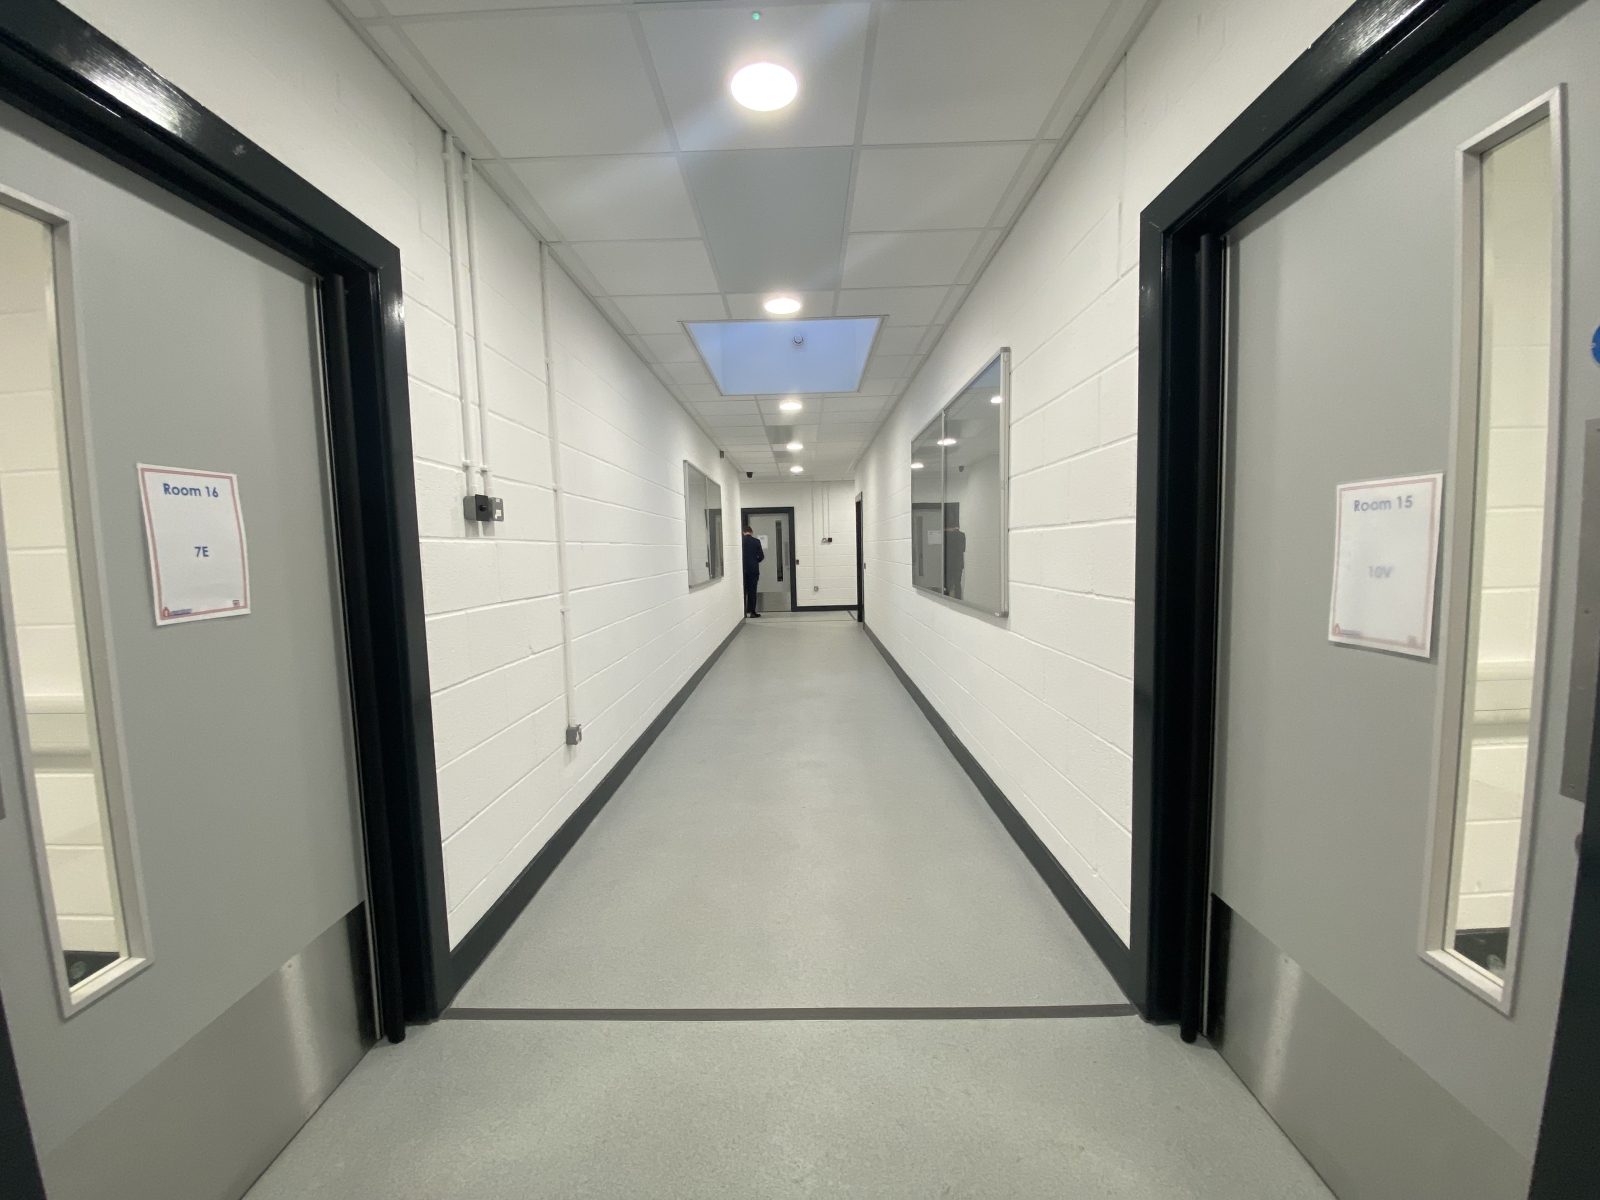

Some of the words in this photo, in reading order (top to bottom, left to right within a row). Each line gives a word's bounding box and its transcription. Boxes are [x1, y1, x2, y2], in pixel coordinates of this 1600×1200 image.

[163, 483, 202, 497] Room
[205, 486, 219, 498] 16
[1354, 499, 1392, 512] Room
[1397, 495, 1413, 509] 15
[194, 546, 209, 557] 7E
